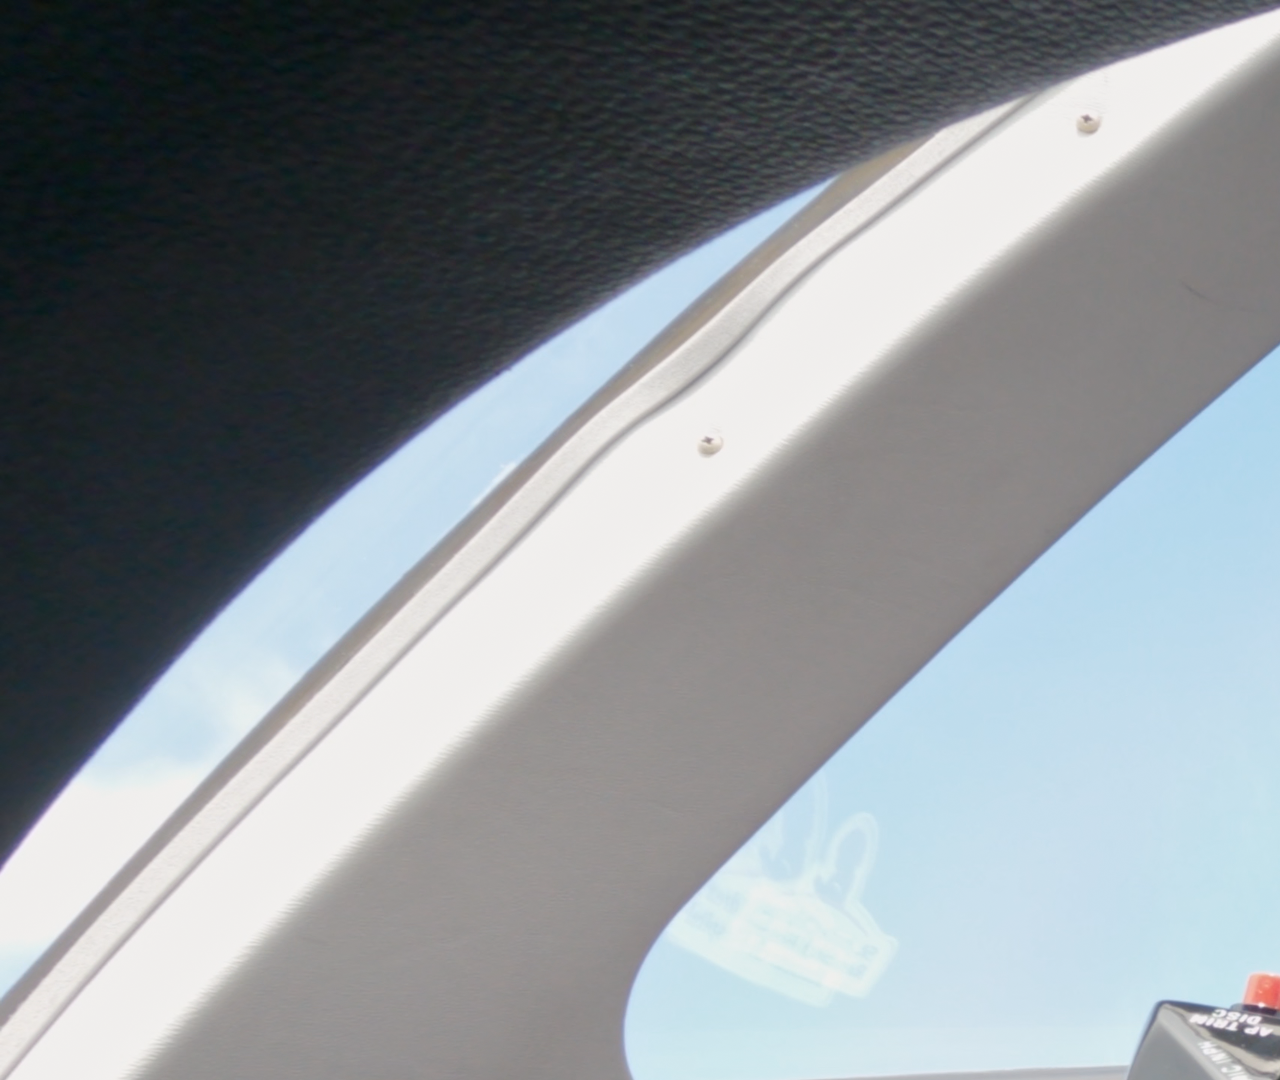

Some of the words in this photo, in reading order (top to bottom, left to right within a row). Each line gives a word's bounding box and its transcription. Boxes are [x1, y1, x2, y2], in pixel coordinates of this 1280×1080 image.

[1189, 1013, 1241, 1032] TRIM
[1212, 1008, 1262, 1026] DISC
[1243, 1025, 1274, 1038] AP
